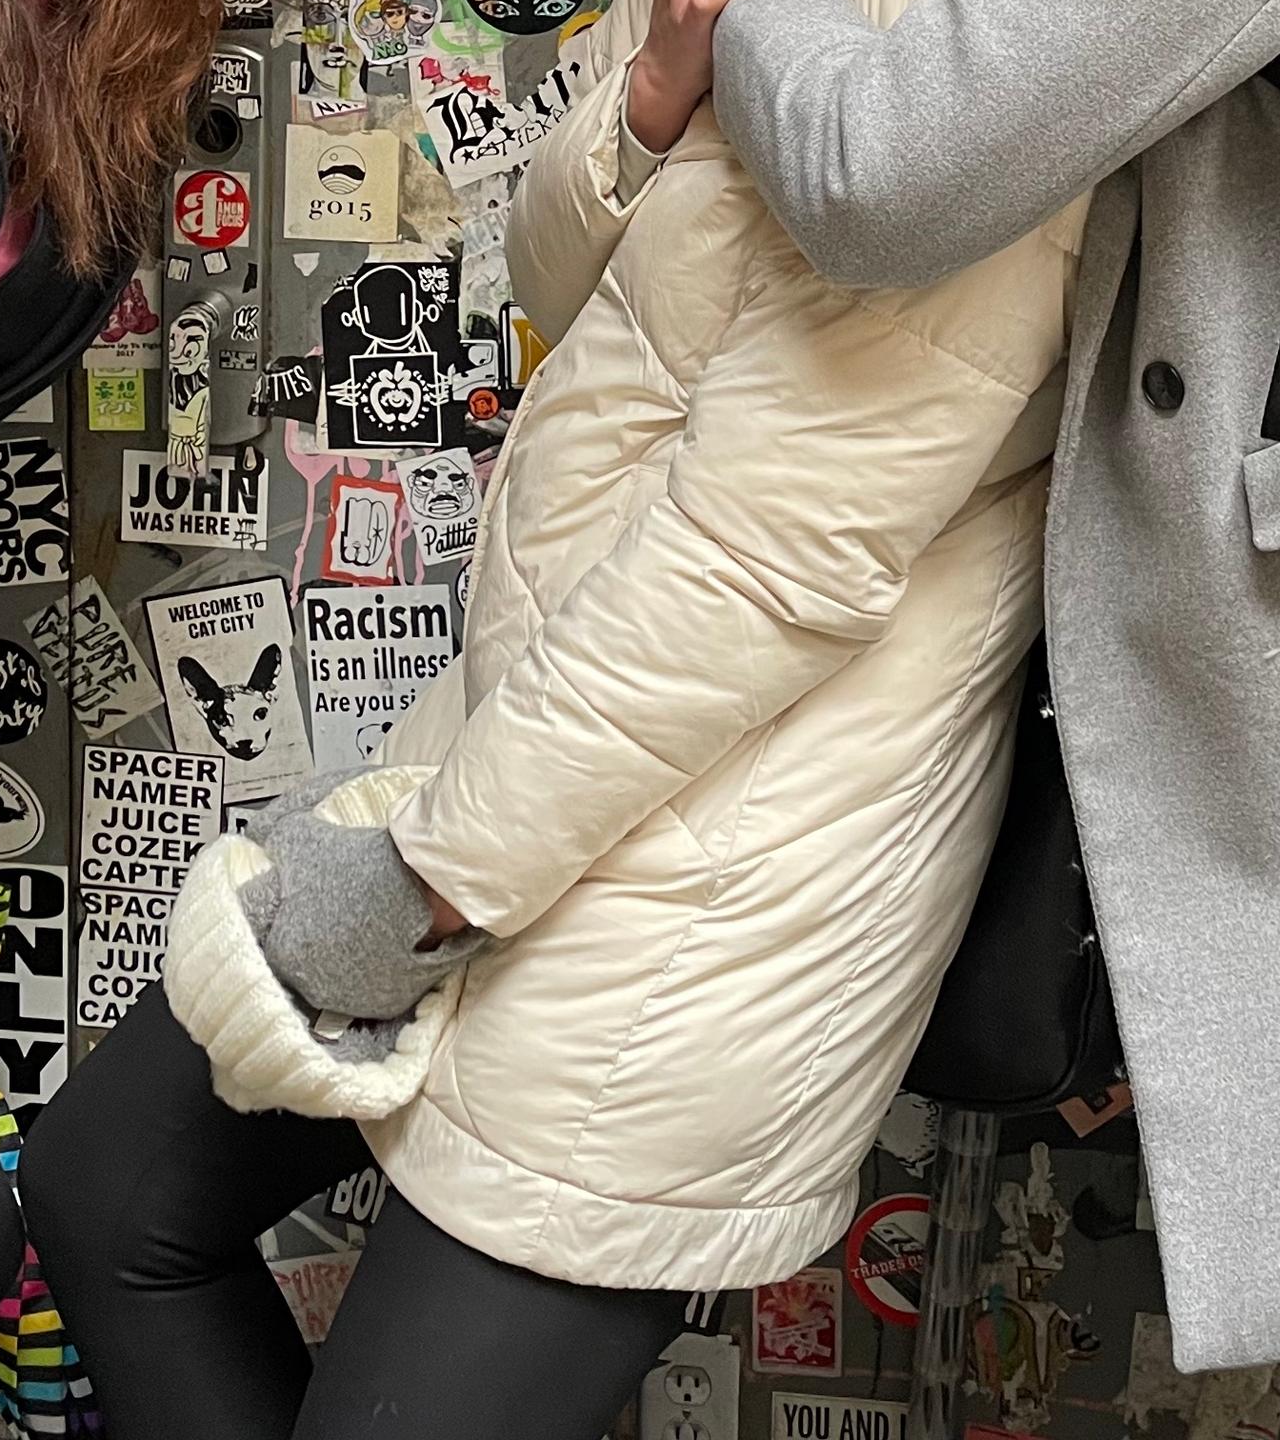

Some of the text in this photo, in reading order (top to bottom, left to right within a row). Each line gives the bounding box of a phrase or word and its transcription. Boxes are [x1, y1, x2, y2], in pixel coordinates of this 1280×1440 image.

[129, 460, 260, 515] JOHN
[7, 439, 68, 579] NYC
[130, 512, 231, 536] WAS HERE
[168, 592, 265, 625] WELCOME TO
[308, 596, 449, 641] Racism
[188, 612, 255, 641] CAT CITY
[311, 648, 451, 681] is an illness
[315, 692, 393, 720] Are you
[87, 750, 218, 783] SPACER
[93, 777, 212, 808] NAMER
[102, 809, 203, 837] JUICE
[81, 859, 187, 889] CAPTE
[851, 1258, 905, 1278] TRADES
[783, 1402, 889, 1440] YOU AND
